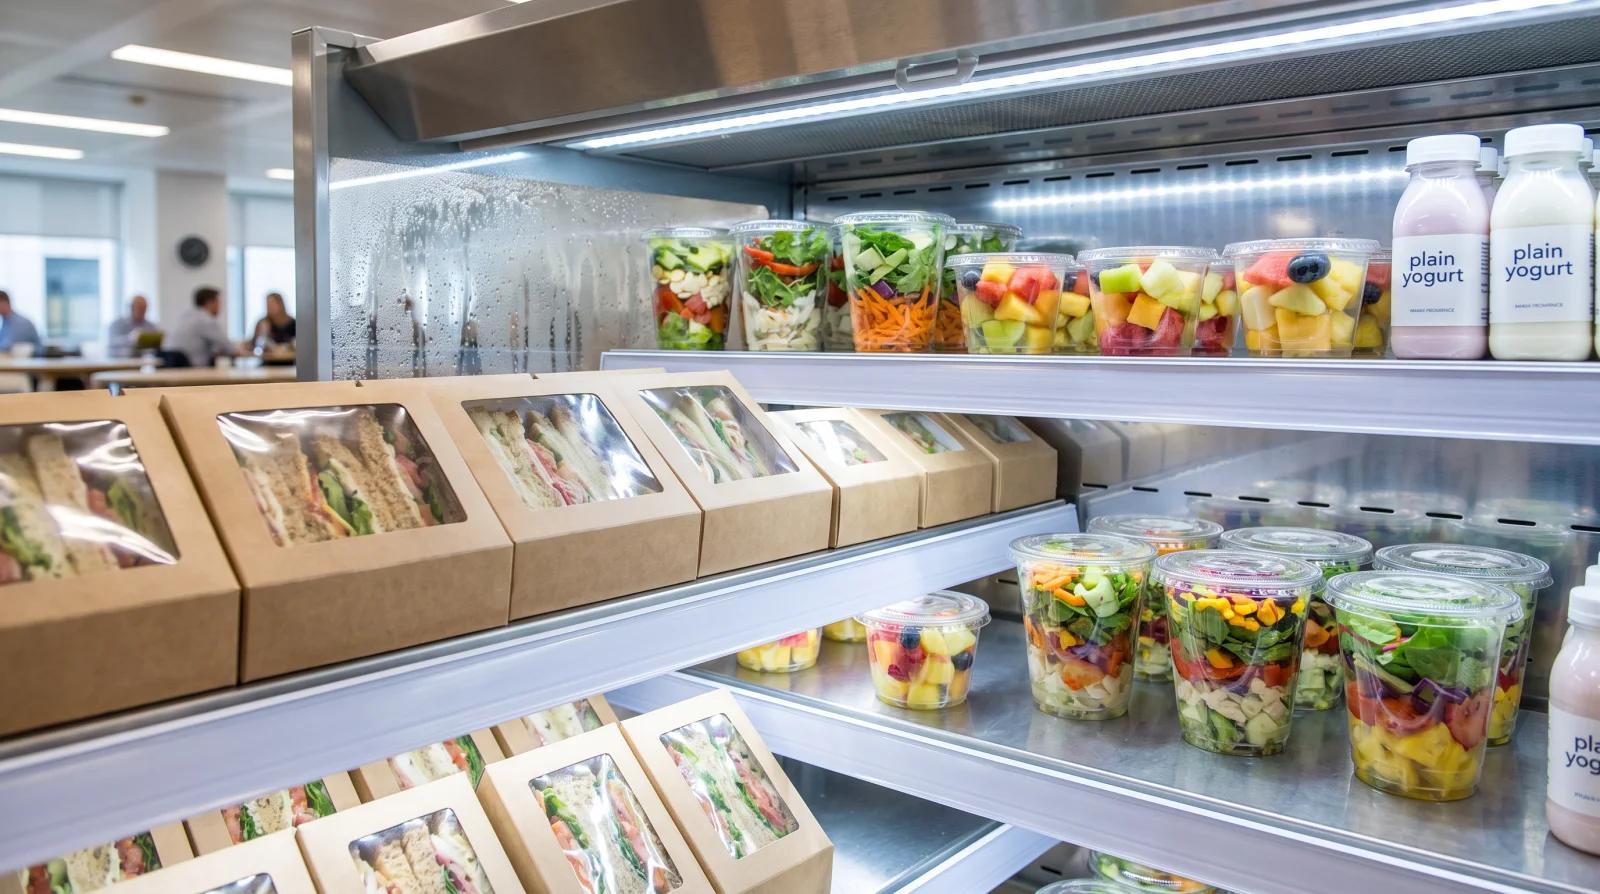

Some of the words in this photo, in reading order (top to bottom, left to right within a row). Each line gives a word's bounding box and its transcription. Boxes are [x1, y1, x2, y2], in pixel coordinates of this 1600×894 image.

[1410, 250, 1455, 271] plain
[1514, 242, 1563, 265] plain
[1402, 269, 1464, 288] yogurt
[1505, 261, 1573, 282] yogurt
